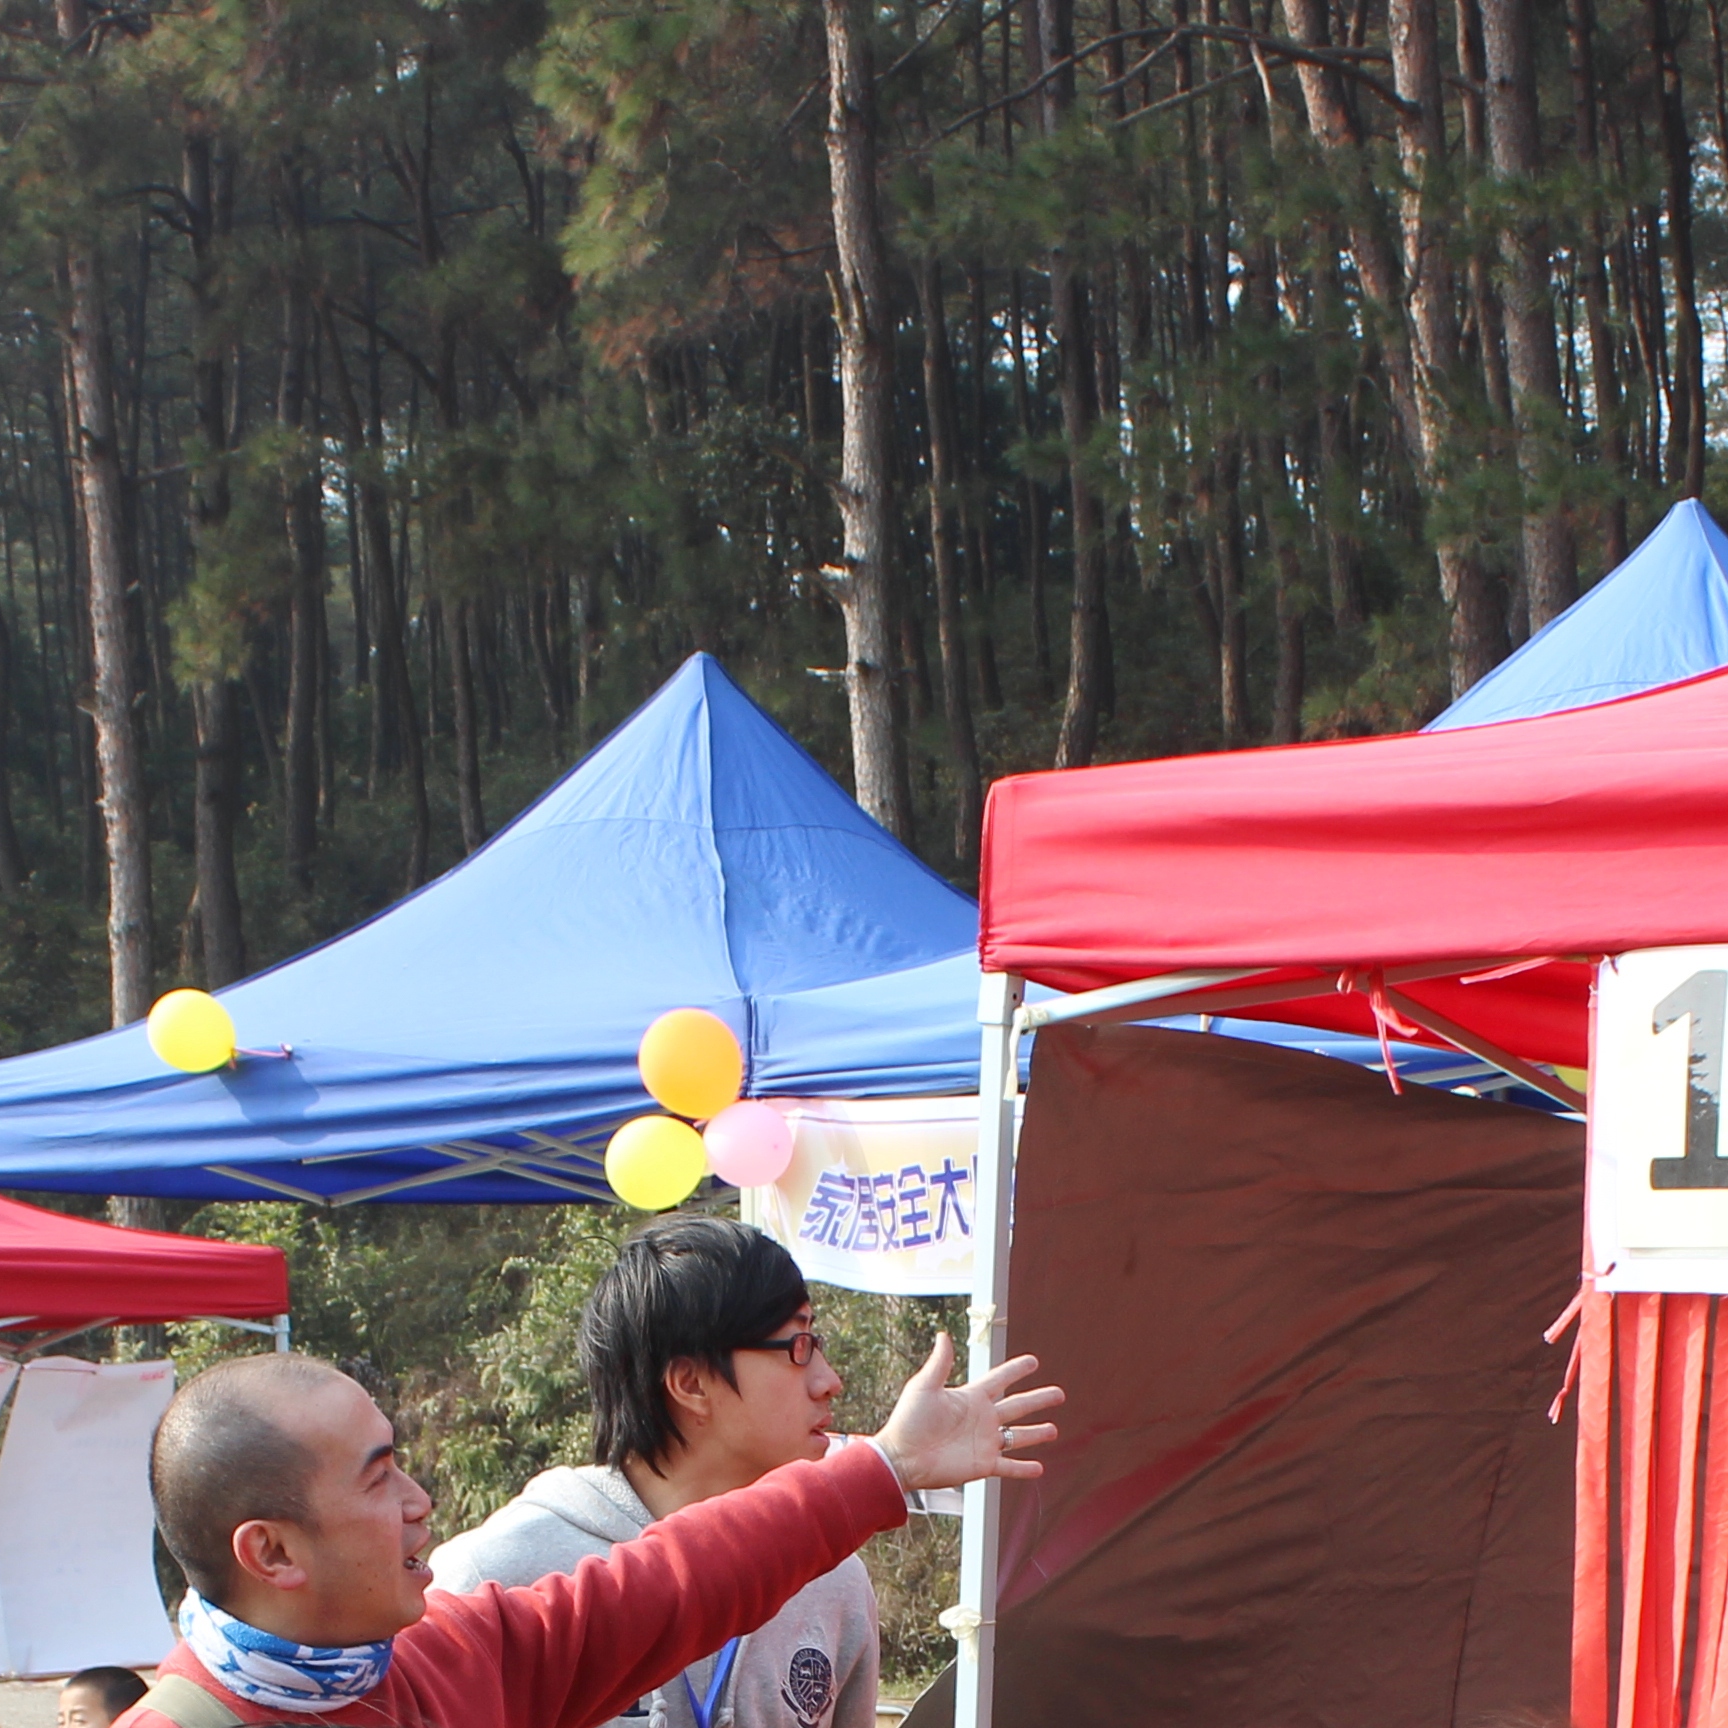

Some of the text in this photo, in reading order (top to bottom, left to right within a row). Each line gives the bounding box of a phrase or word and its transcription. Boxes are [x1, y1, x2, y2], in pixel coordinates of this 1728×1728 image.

[799, 1154, 978, 1252] 家居安全大
